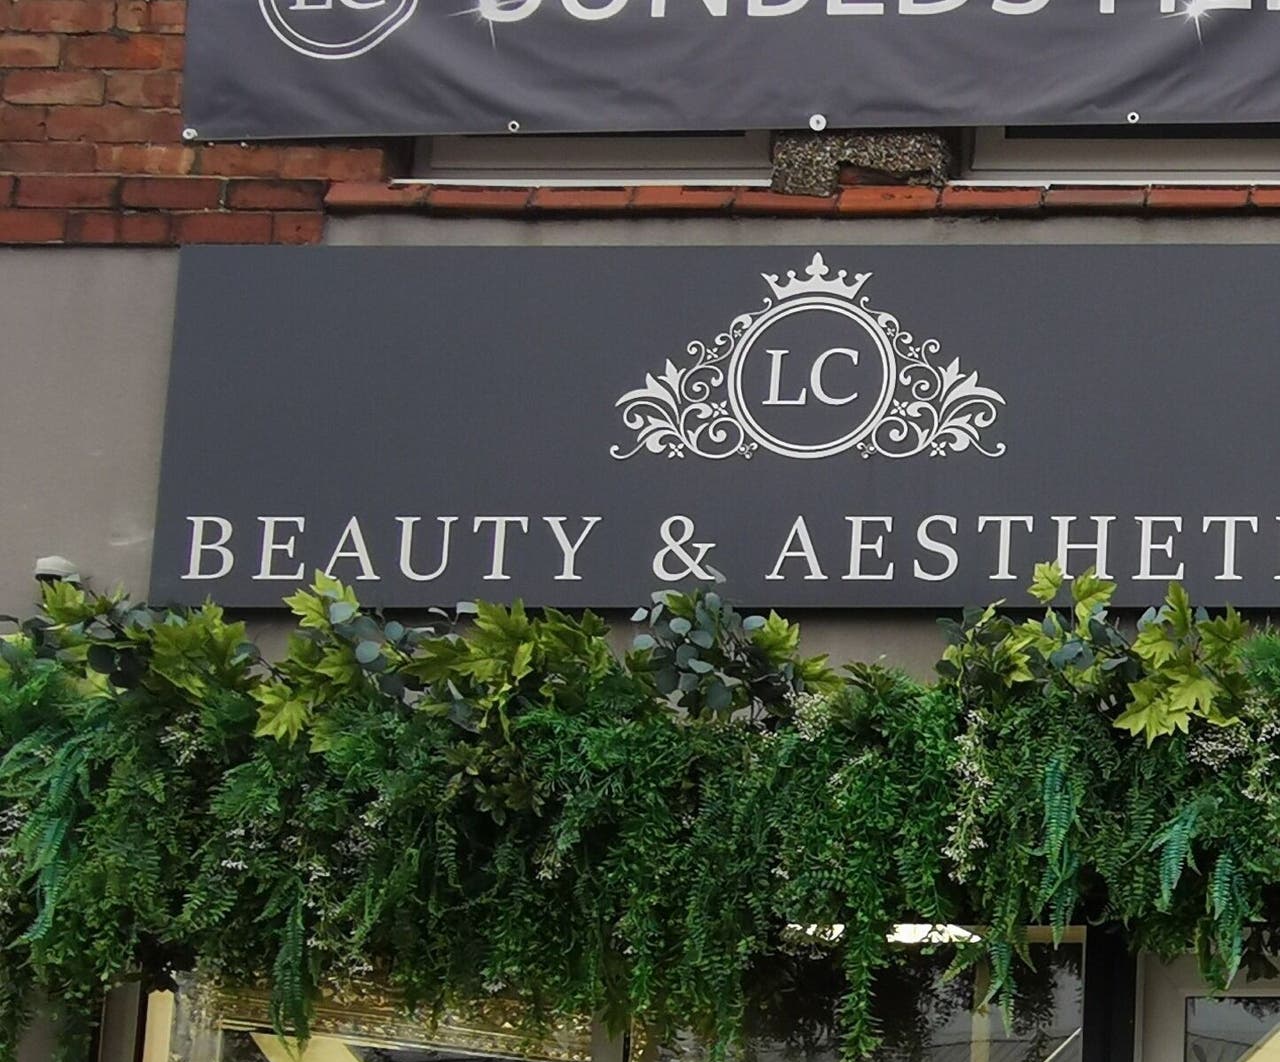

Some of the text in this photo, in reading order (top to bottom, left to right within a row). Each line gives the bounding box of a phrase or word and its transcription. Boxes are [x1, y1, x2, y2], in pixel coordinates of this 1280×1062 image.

[762, 347, 859, 406] LC
[181, 515, 602, 581] BEAUTY
[653, 515, 724, 582] &
